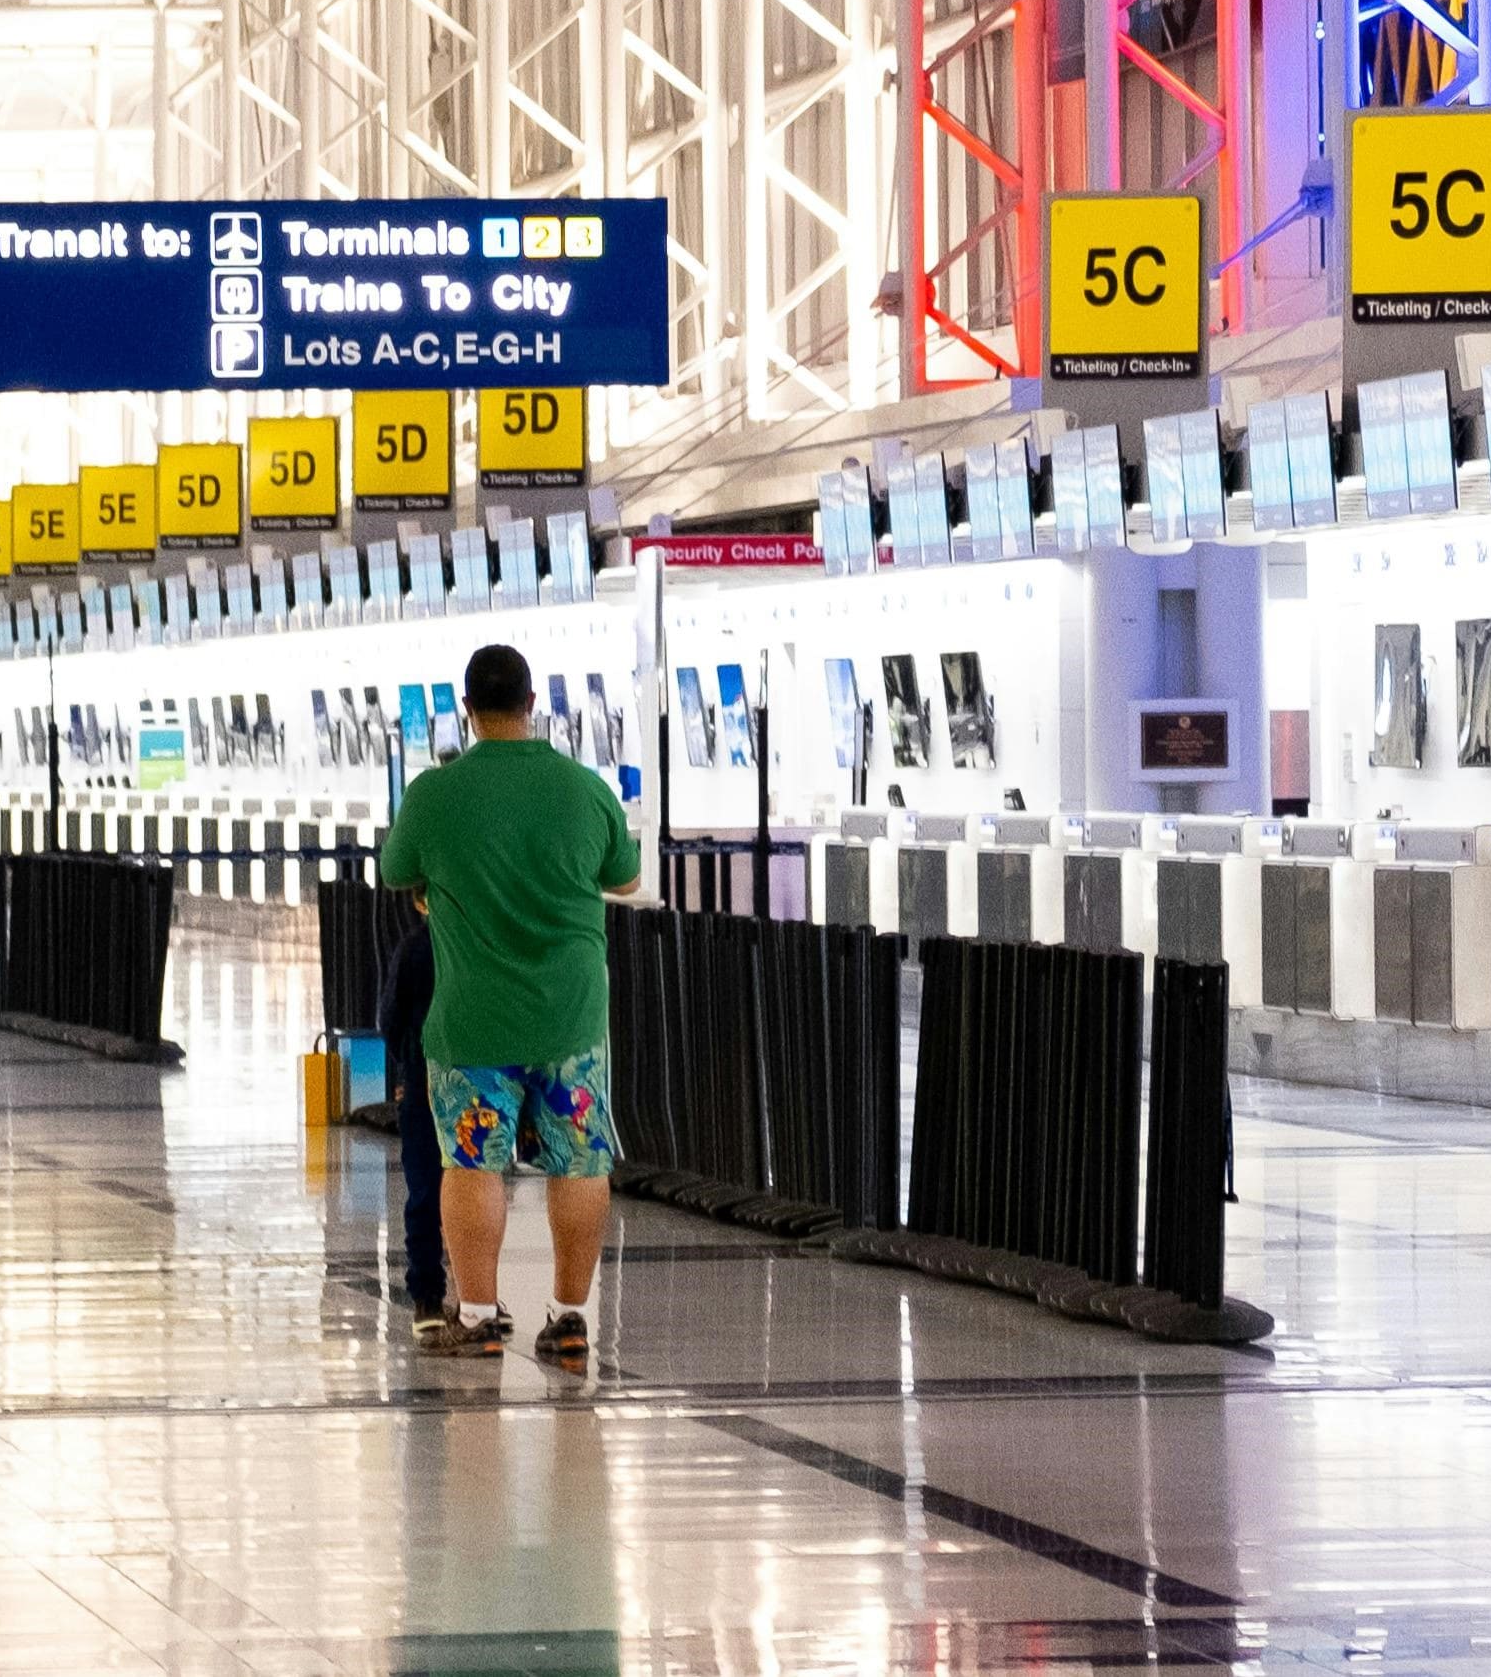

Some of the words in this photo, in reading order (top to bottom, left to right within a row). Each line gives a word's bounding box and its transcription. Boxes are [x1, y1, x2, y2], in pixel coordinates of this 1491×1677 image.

[1389, 167, 1486, 239] 5C
[143, 224, 191, 259] to:
[282, 220, 470, 257] Terminals
[1083, 245, 1166, 307] 5C
[282, 277, 402, 313] Trains
[422, 277, 470, 312] To
[491, 275, 571, 315] City
[1367, 299, 1431, 319] Ticketing
[285, 335, 362, 366] Lots
[1063, 358, 1118, 377] Ticketing
[1130, 357, 1184, 375] Check-In
[502, 393, 559, 435] 5D
[376, 424, 428, 463] 5D
[270, 450, 316, 486] 5D
[177, 474, 221, 507] 5D
[29, 509, 65, 539] 5E
[99, 494, 137, 525] 5E
[665, 544, 723, 563] ecurity
[731, 544, 785, 561] Check
